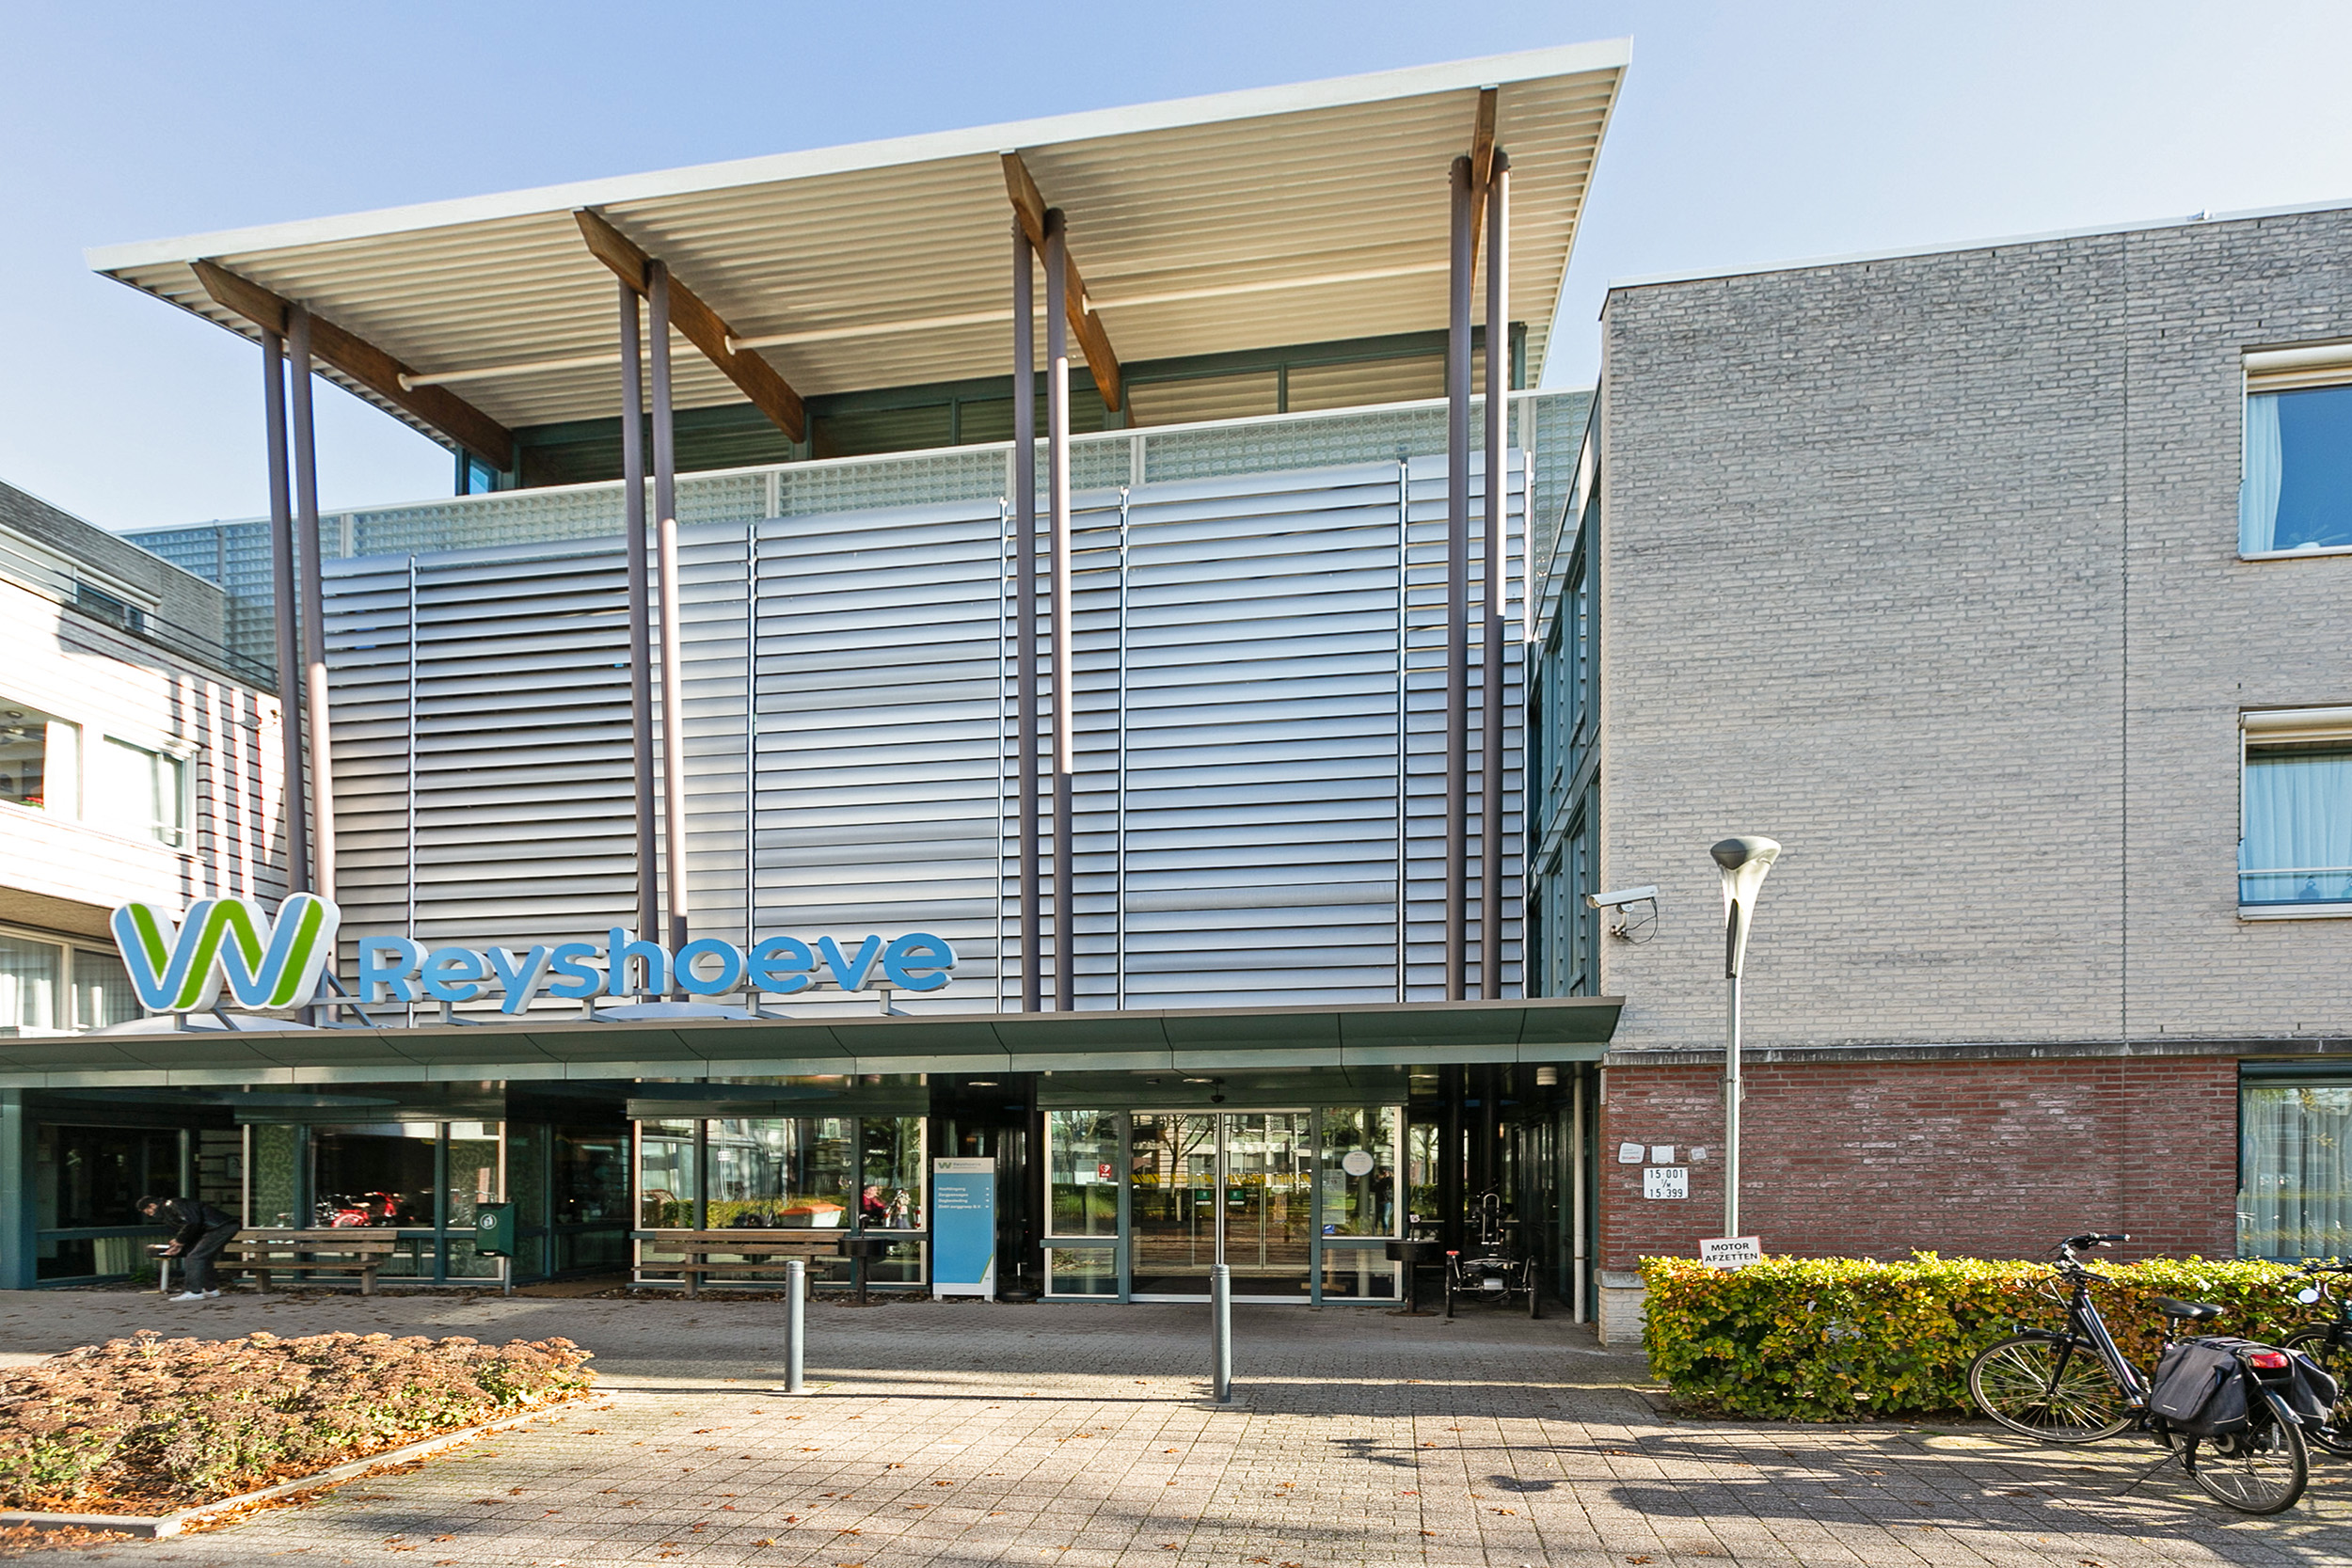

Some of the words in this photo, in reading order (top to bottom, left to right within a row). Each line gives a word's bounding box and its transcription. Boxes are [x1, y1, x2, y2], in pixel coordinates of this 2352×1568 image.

[359, 927, 958, 1015] Reyshoeve
[1710, 1243, 1750, 1252] MOTOR
[1705, 1252, 1758, 1262] AFZETTEN
